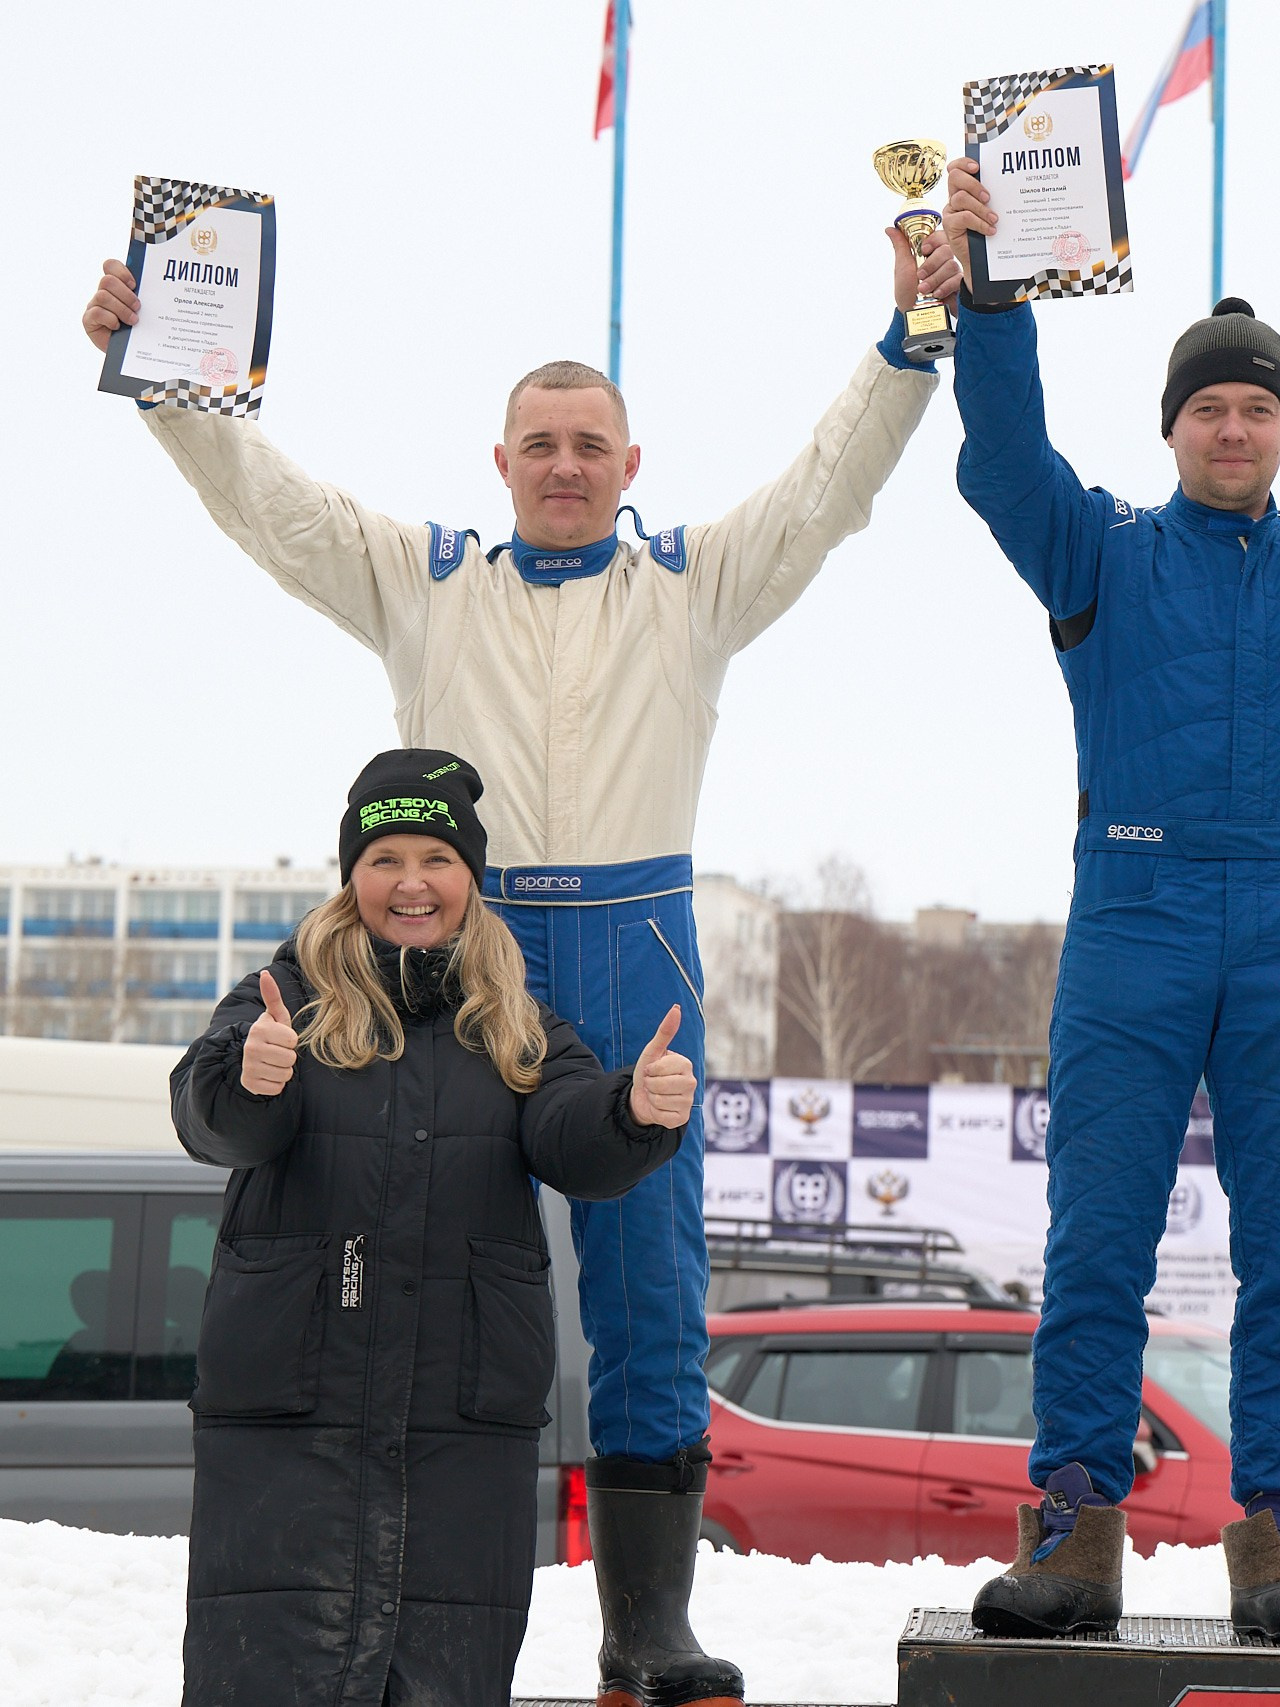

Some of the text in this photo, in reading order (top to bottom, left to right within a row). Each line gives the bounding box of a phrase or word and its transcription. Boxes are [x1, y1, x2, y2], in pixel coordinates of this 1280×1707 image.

[1001, 146, 1081, 175] ДИПЛОМ
[1025, 173, 1059, 182] НАГРАЖДАЕТСЯ
[163, 259, 239, 288] ДИПЛОМ
[184, 287, 216, 296] НАГРАЖДАЕТСЯ
[173, 297, 224, 309] Орлов Александр
[535, 557, 582, 569] sparco
[1107, 824, 1163, 841] sparco
[514, 875, 581, 892] sparco
